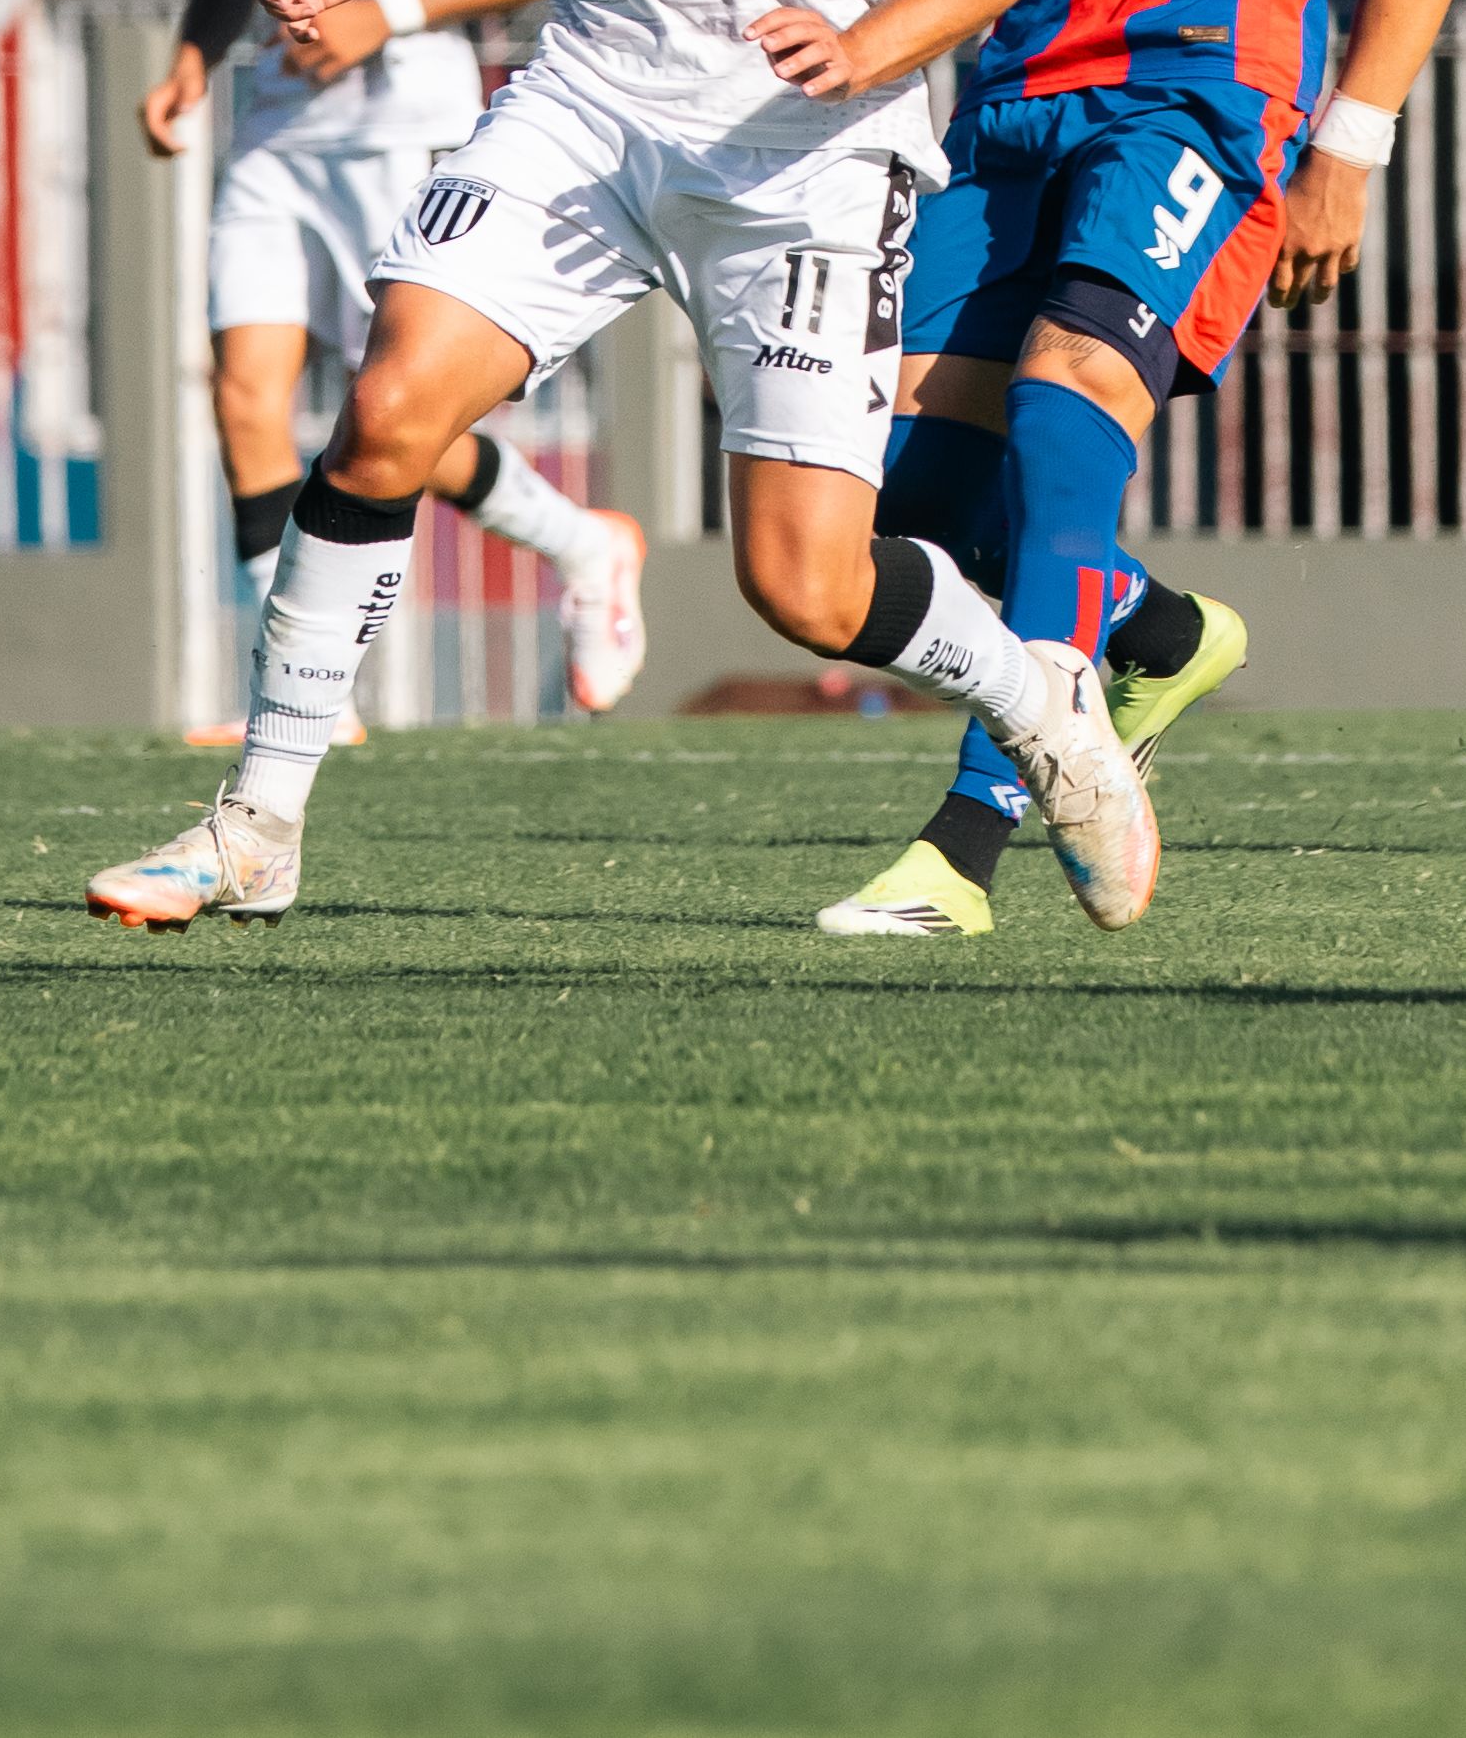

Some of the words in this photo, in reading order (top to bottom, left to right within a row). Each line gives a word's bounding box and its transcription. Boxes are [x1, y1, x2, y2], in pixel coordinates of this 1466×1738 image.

[1153, 147, 1224, 253] 9
[781, 252, 830, 334] 11
[752, 344, 832, 374] Mitre
[282, 663, 345, 681] 1908
